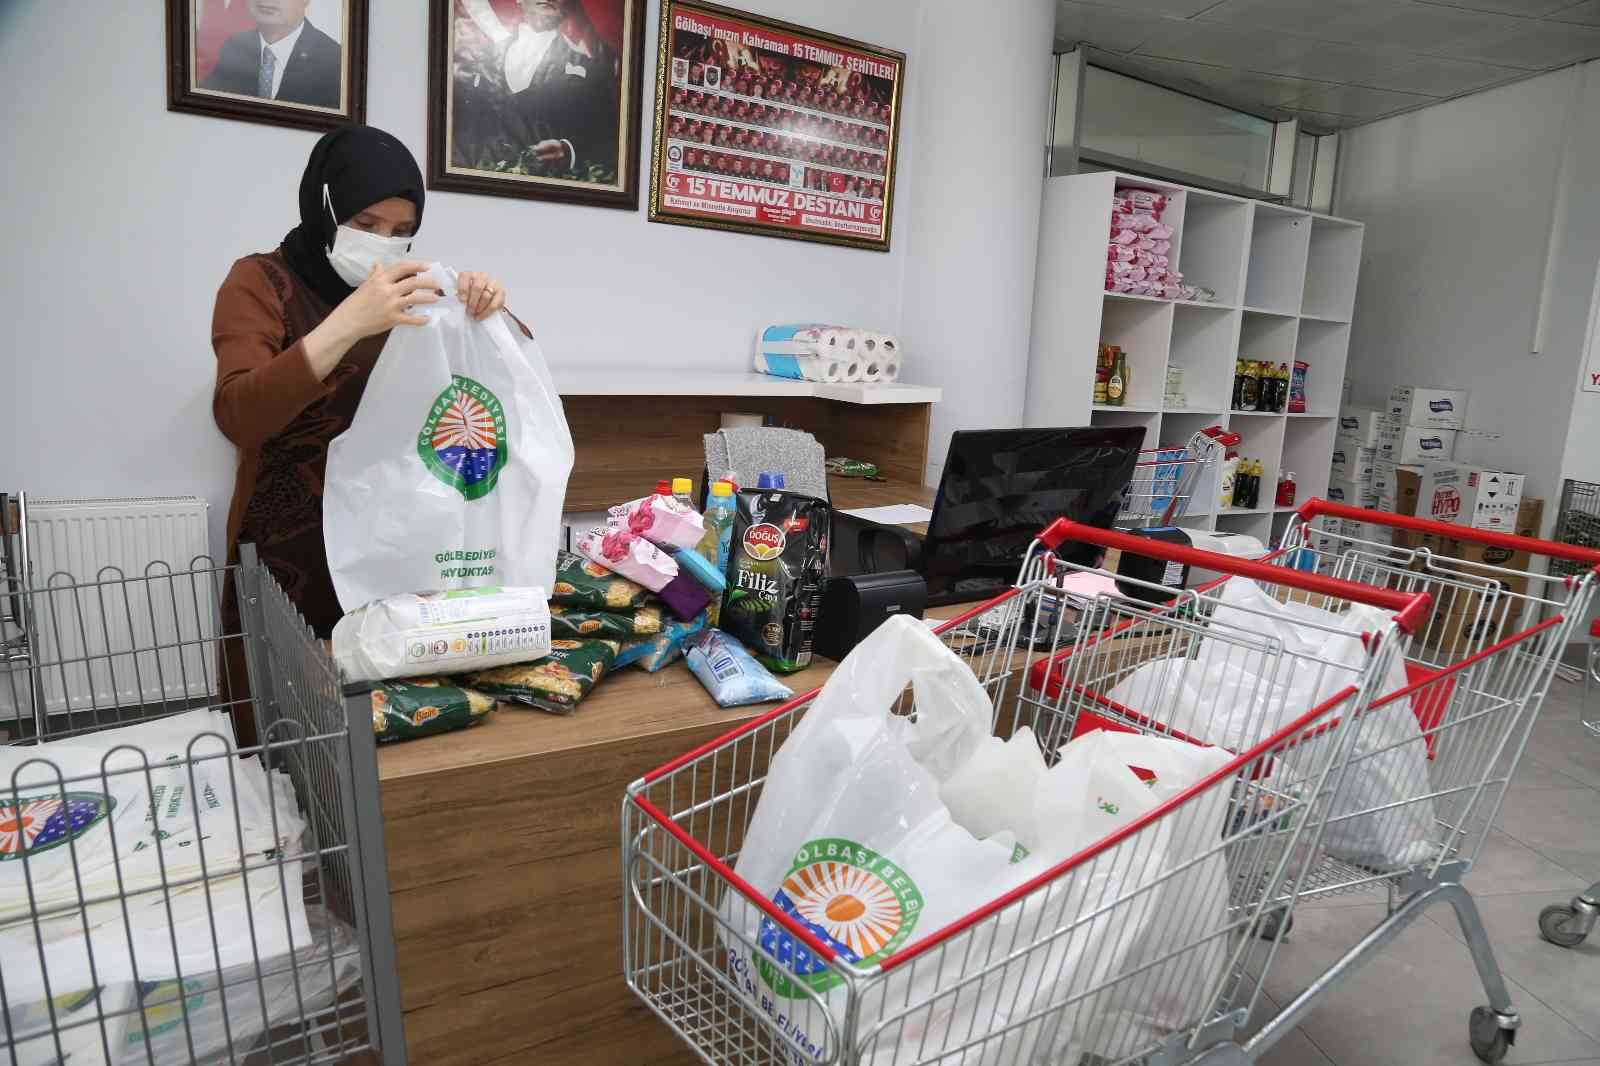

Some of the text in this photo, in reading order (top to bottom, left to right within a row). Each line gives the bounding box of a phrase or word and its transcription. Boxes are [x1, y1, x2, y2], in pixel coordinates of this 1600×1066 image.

[675, 15, 740, 41] Gölbaşı'mızın
[742, 32, 789, 54] Kahraman
[793, 43, 803, 57] 15
[804, 46, 845, 67] TEMMUZ
[687, 177, 706, 195] 15
[707, 180, 789, 208] TEMMUZ
[793, 192, 865, 219] DESTANI
[749, 529, 780, 545] DOĞUŞ
[737, 568, 781, 595] Filiz
